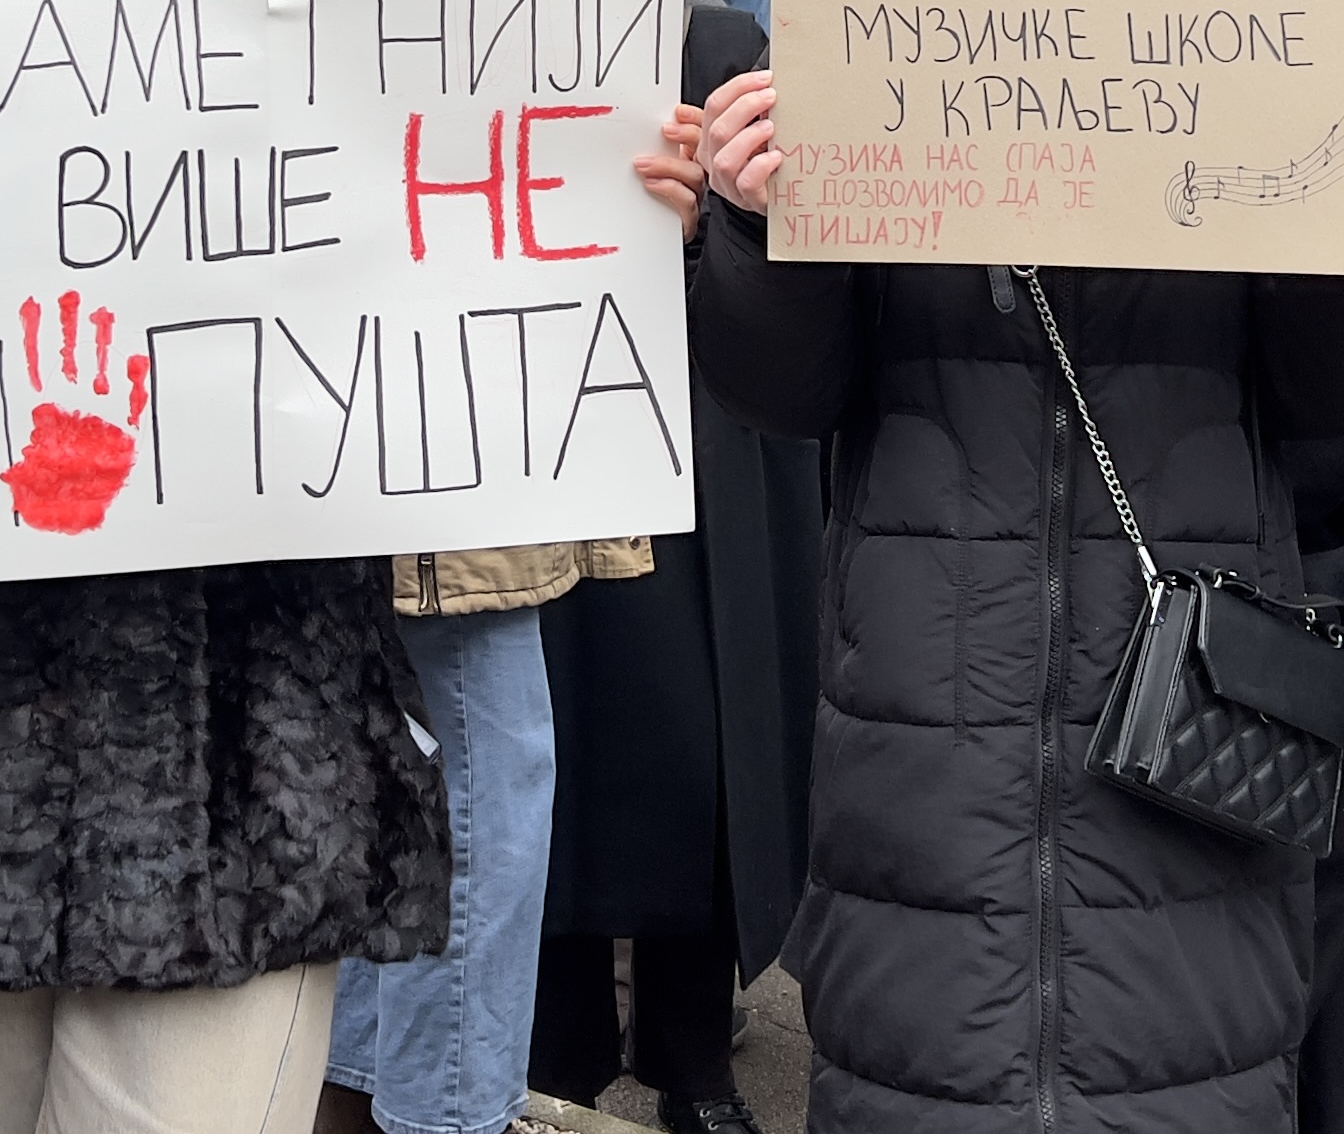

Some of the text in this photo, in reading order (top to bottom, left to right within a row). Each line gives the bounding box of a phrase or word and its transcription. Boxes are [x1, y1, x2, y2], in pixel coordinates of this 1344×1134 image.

[842, 4, 1313, 66] МУЗИЧКЕ ШКОЛЕ
[883, 75, 1199, 138] У КРАЉЕВУ
[926, 143, 979, 172] НАС
[58, 105, 621, 270] ВИШЕ НЕ
[773, 177, 1096, 210] НЕ ДОЗВОЛИМО ДА ЈЕ
[784, 211, 944, 252] УТИШАЈУ!
